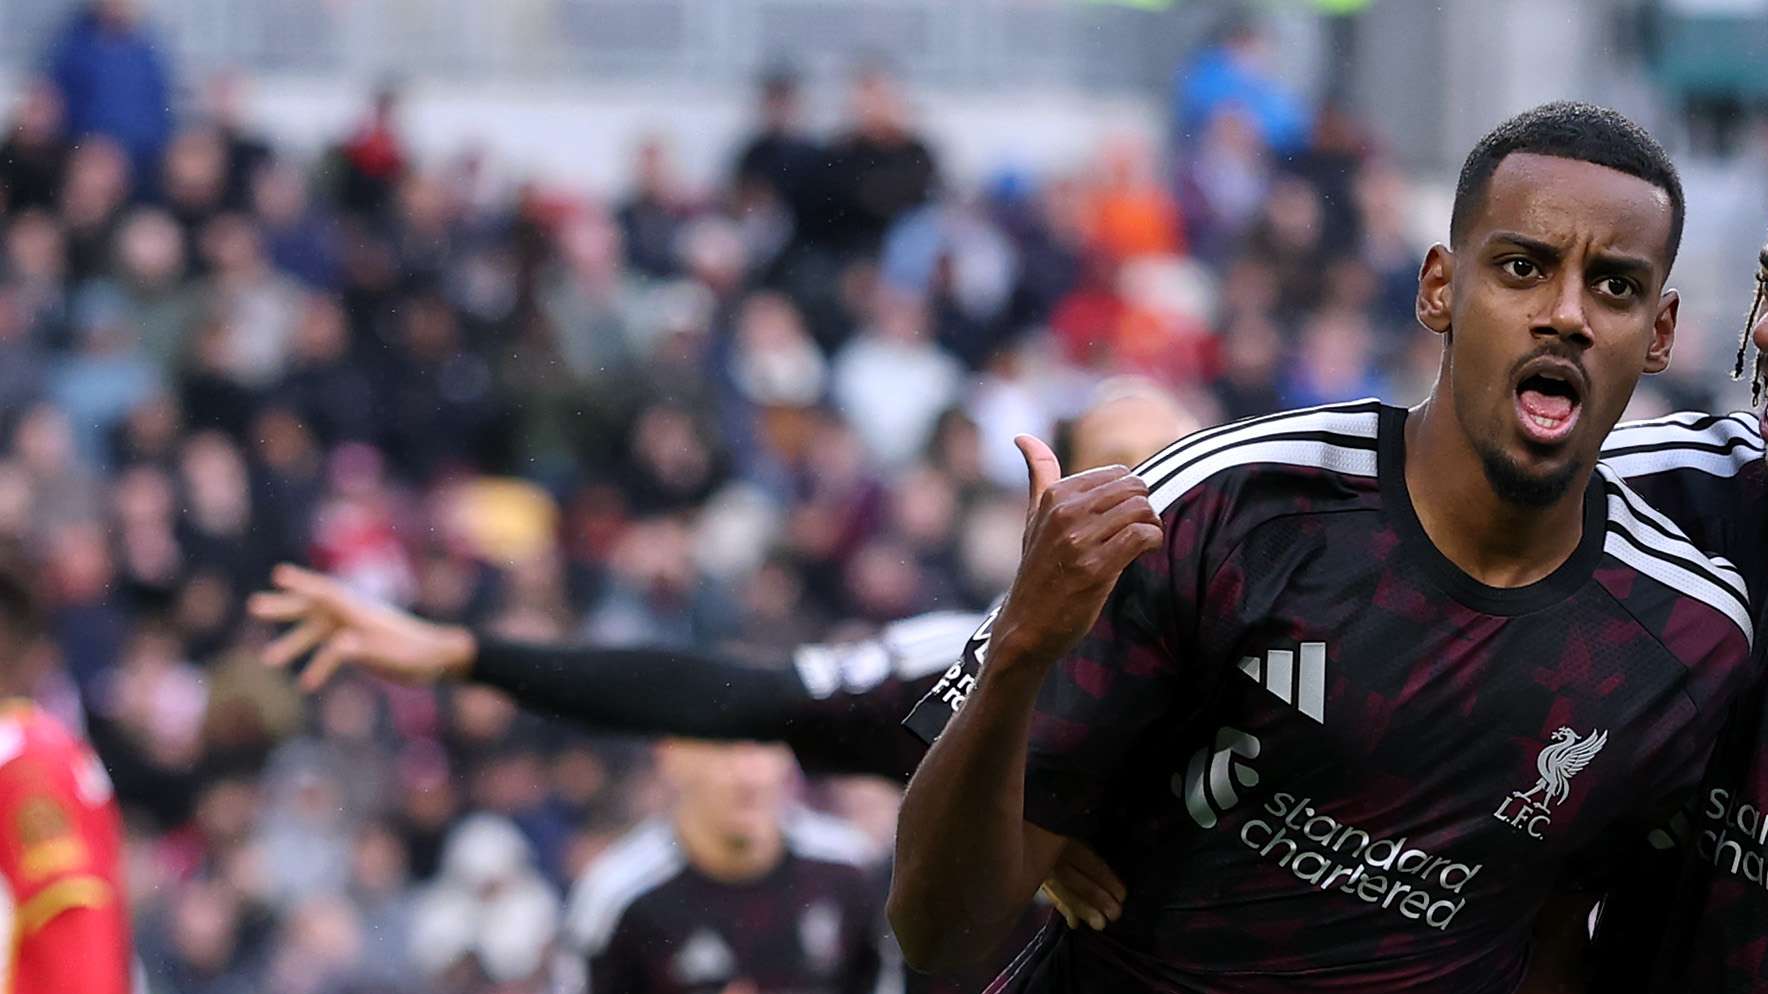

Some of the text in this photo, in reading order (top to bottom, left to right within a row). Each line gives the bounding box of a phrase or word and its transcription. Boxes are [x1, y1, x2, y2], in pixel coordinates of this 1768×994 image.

[1264, 792, 1483, 894] standard
[1493, 796, 1551, 840] L.F.C.
[1240, 819, 1466, 931] chartered
